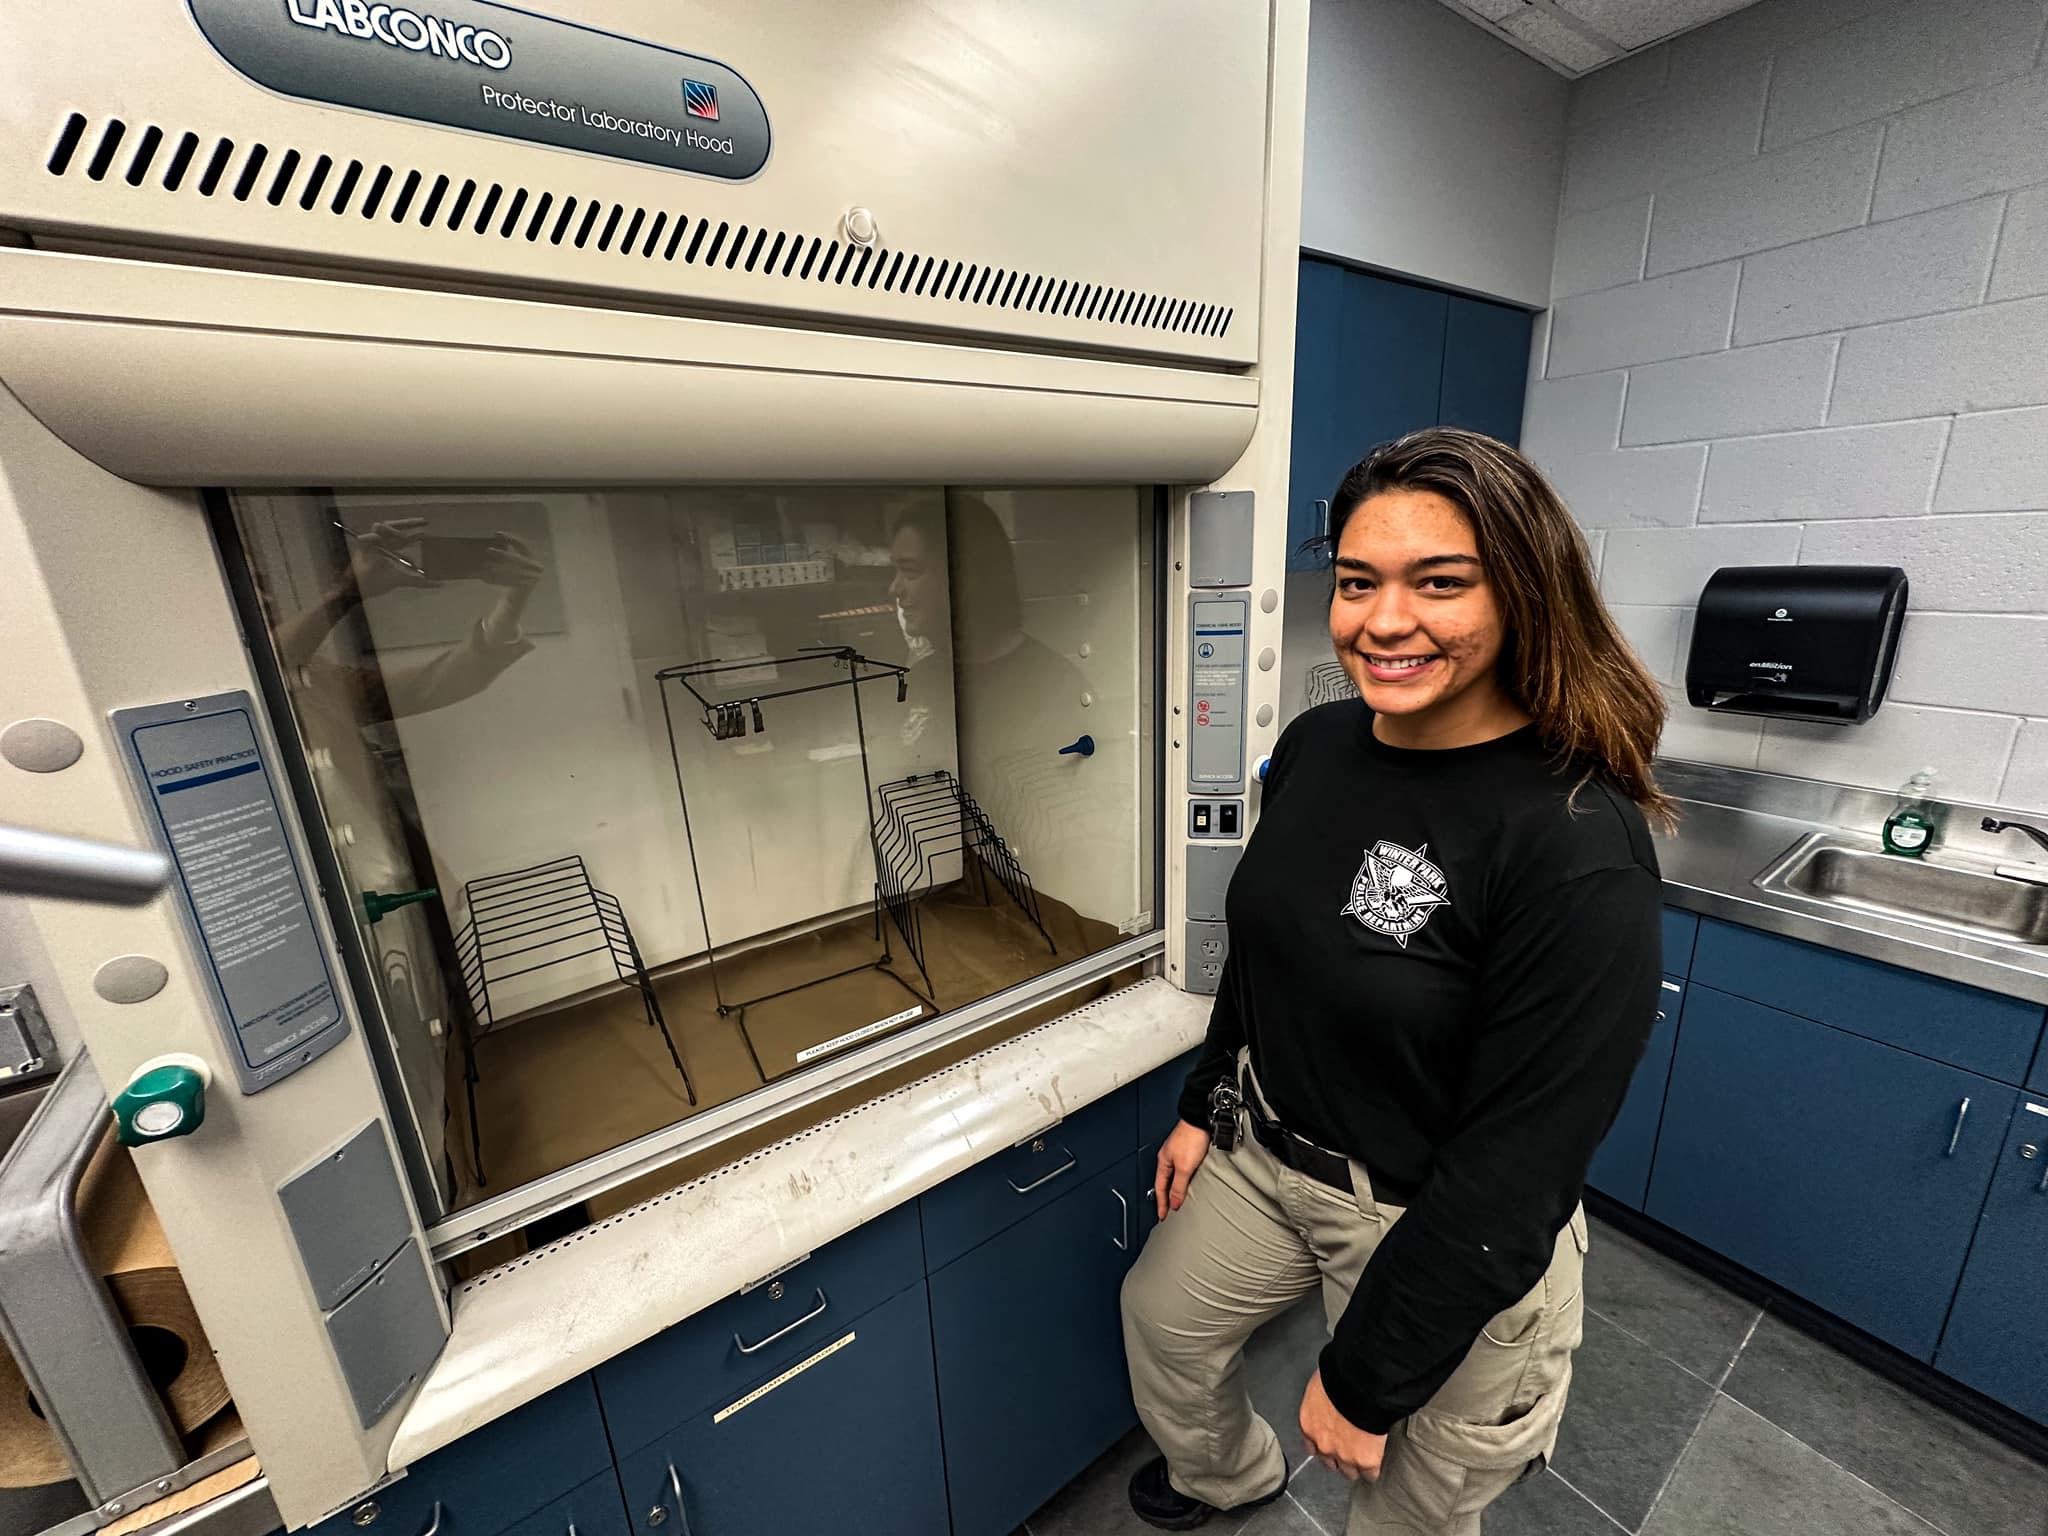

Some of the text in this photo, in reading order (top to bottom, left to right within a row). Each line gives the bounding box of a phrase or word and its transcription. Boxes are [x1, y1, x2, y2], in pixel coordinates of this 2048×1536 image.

[287, 0, 512, 69] LABCONCO
[481, 85, 734, 154] Protector Laboratory Hood
[152, 748, 256, 777] HOOD SAFETY PRACTICES
[1378, 845, 1445, 889] WINTER PARK
[1355, 875, 1369, 912] POLICE
[806, 1046, 825, 1056] PLEASE
[825, 1041, 839, 1050] KEEP
[726, 1375, 787, 1414] TEMPORARY
[788, 1345, 834, 1376] STORAGE
